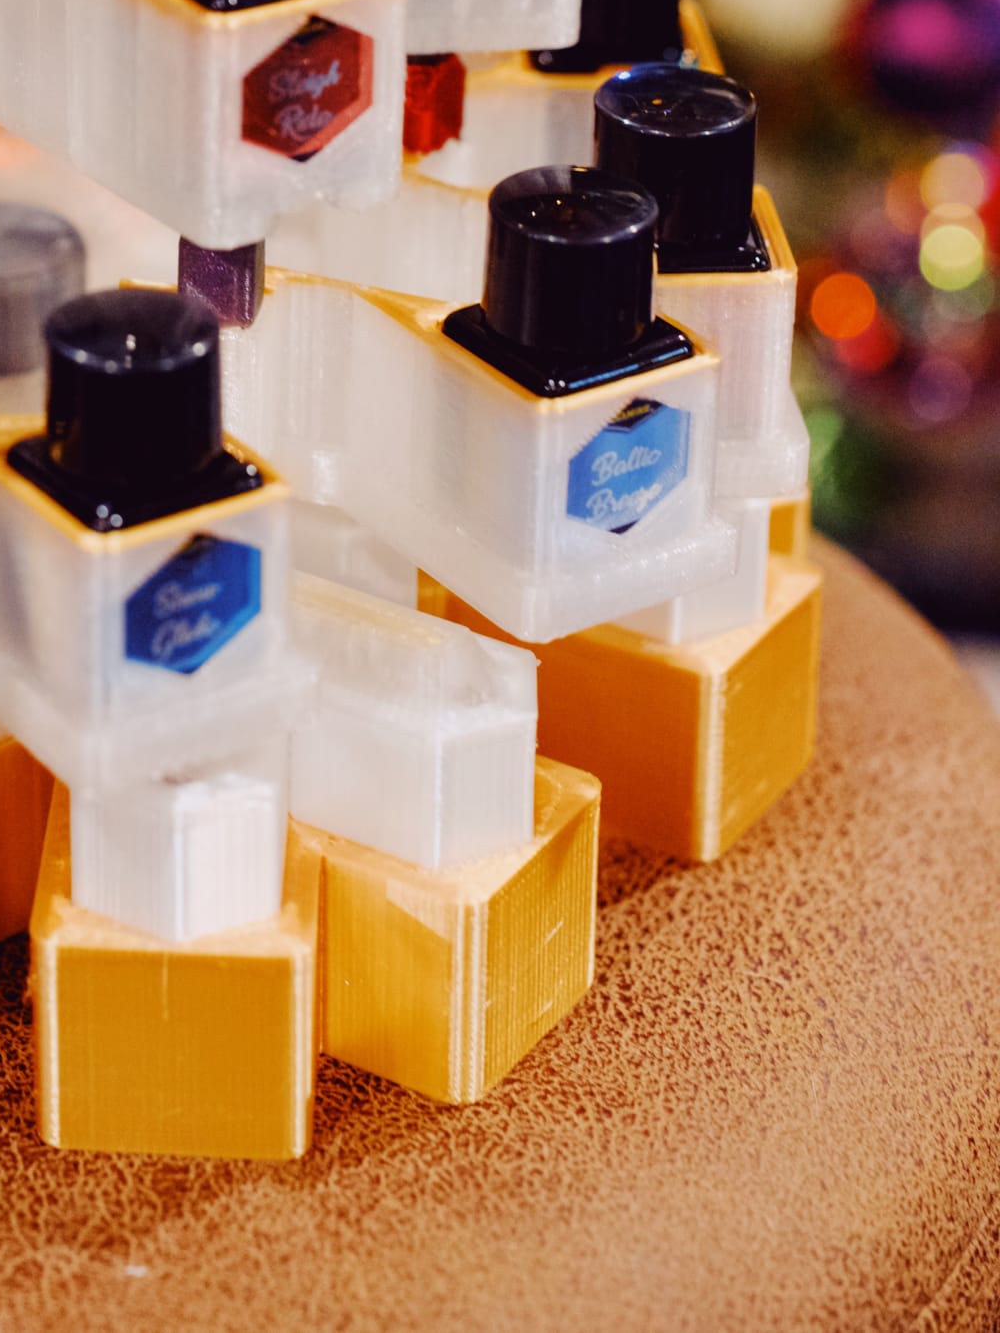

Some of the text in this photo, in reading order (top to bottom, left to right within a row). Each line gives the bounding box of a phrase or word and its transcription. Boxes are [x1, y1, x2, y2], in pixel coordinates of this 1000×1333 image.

[268, 60, 340, 102] Sleigh
[277, 104, 334, 142] Ride
[591, 446, 662, 487] Baltic
